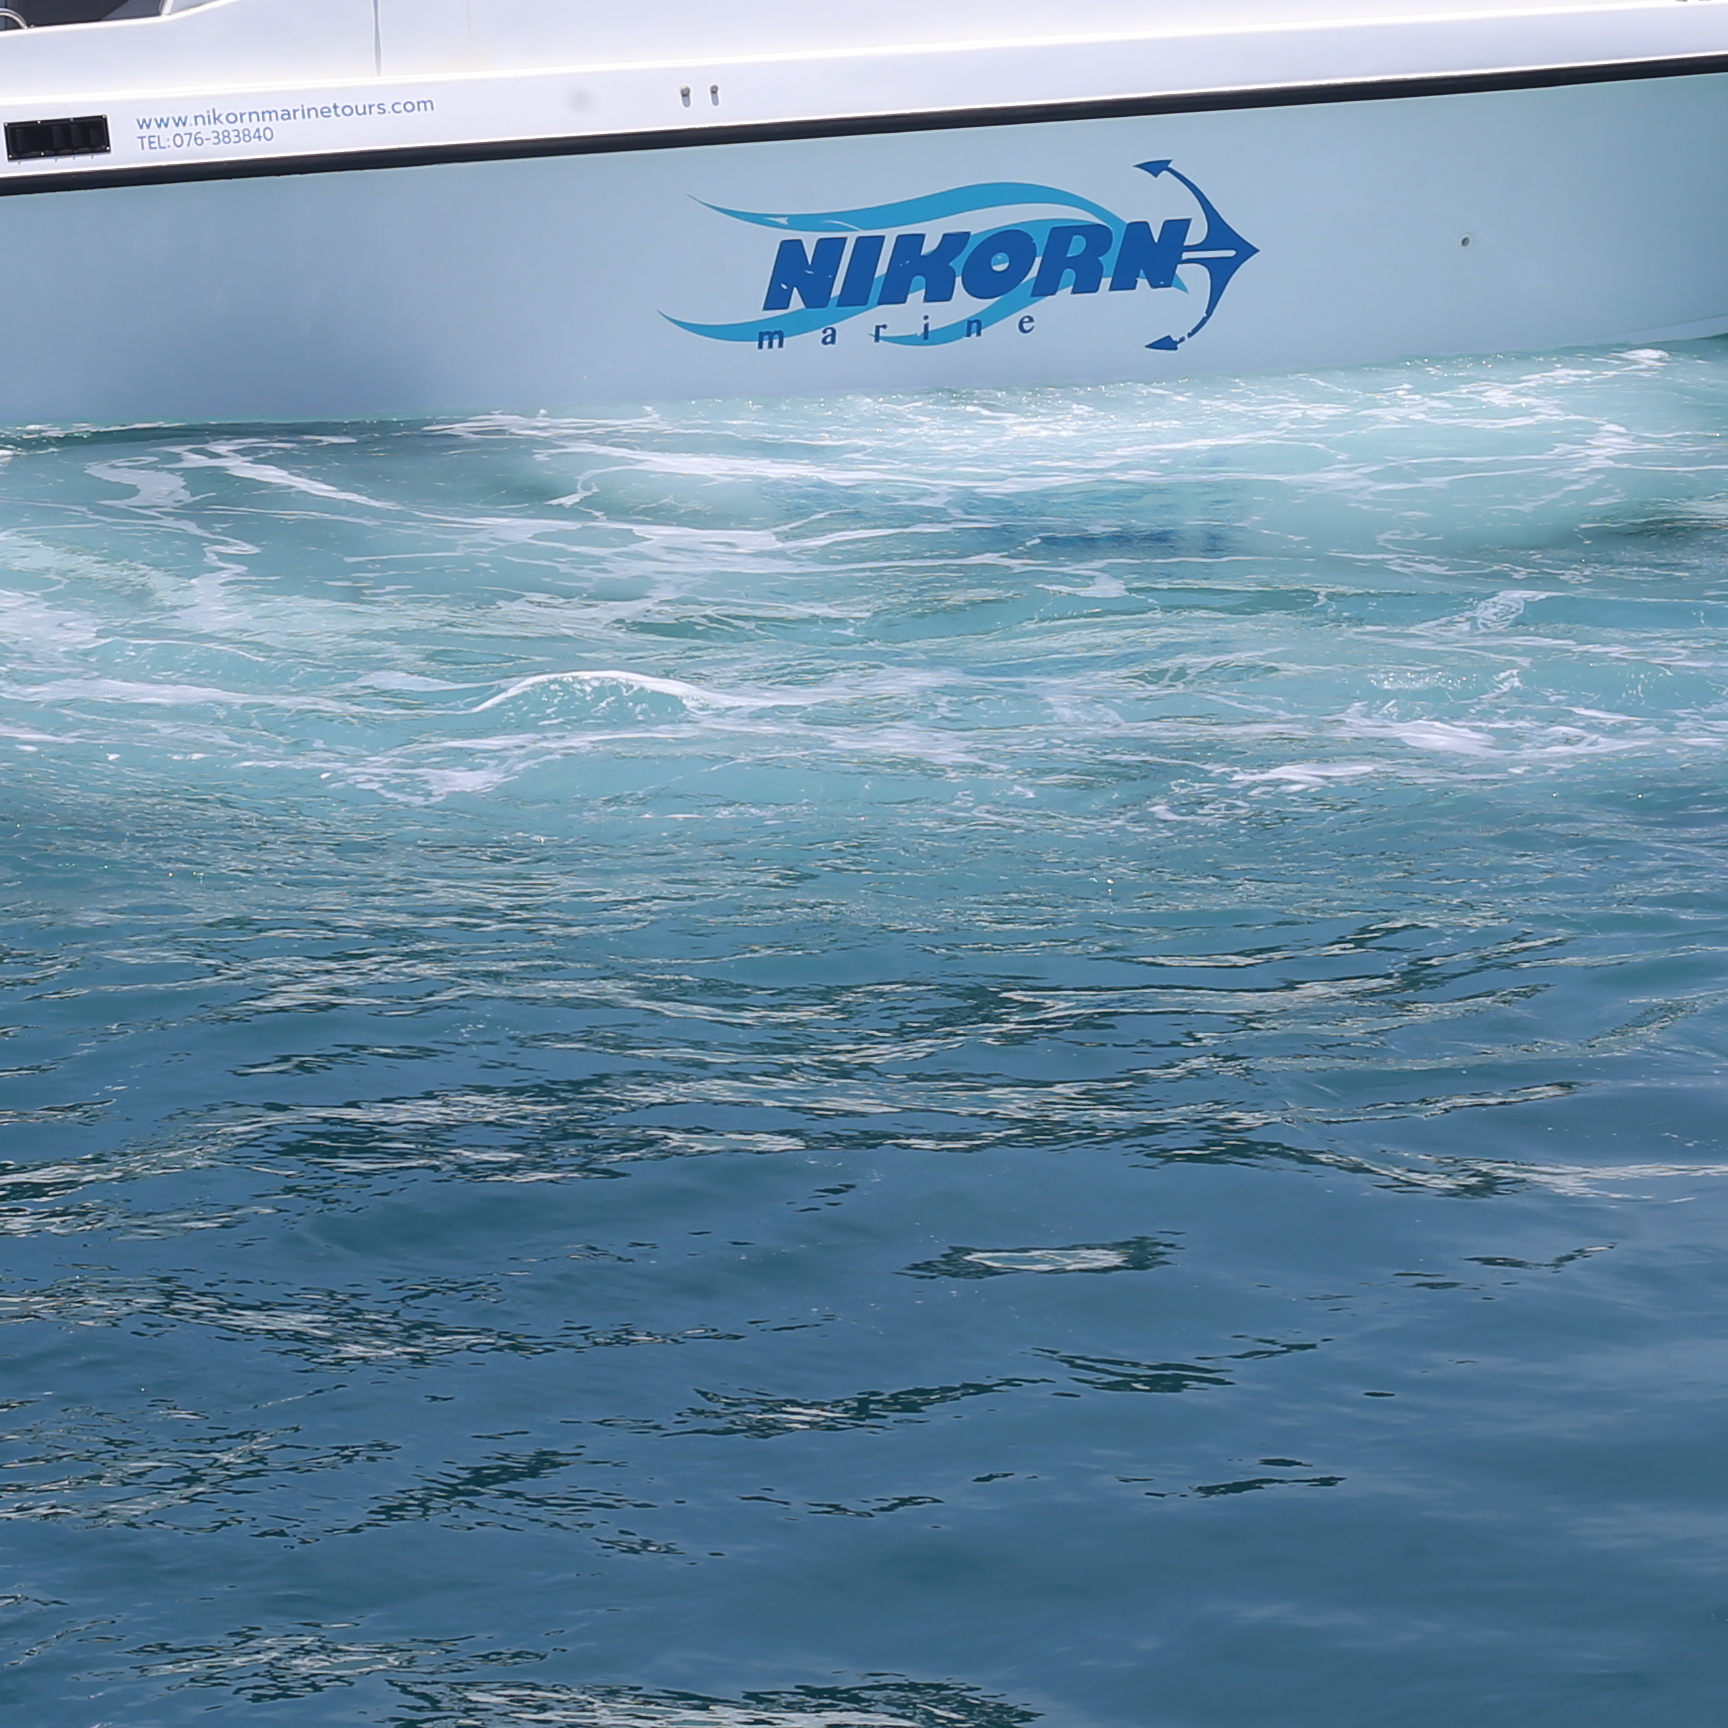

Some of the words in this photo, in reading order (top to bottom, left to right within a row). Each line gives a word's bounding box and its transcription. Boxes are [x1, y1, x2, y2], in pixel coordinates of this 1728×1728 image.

[135, 98, 435, 131] www.nikornmarinetours.com
[762, 218, 1192, 311] NIKORN
[757, 312, 1036, 350] marine
